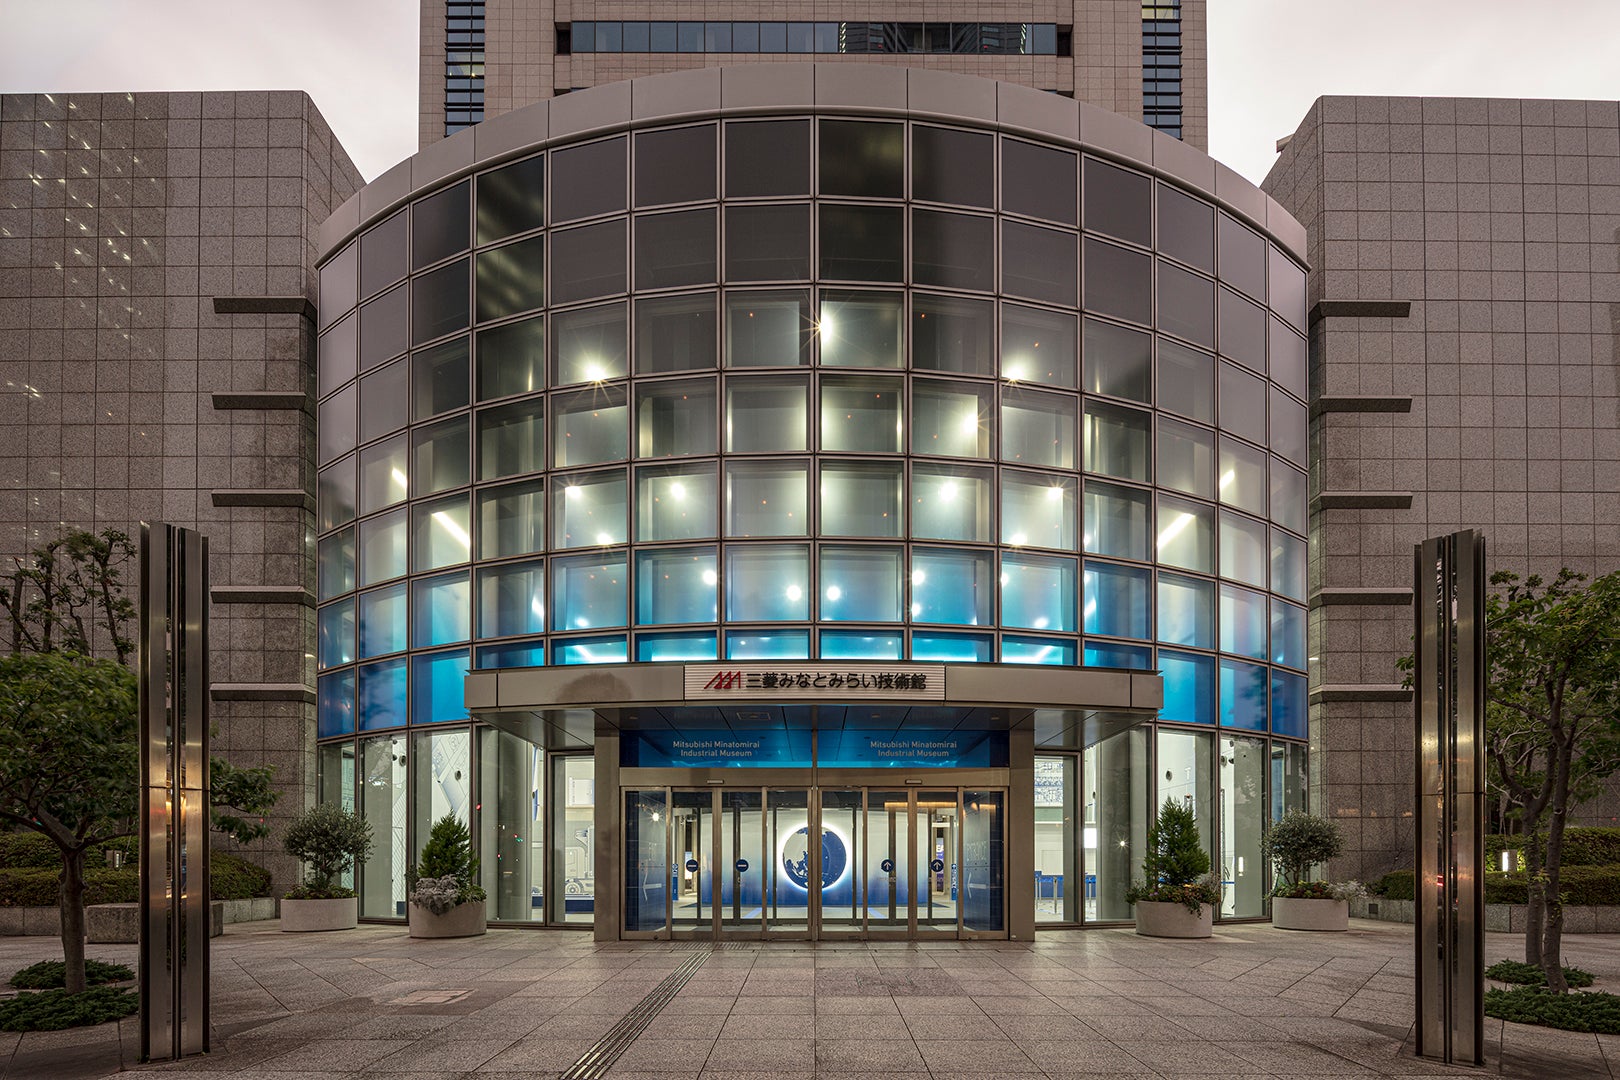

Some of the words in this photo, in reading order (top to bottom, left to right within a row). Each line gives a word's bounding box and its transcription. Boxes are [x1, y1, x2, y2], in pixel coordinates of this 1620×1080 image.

[746, 672, 926, 690] 三菱みなとみらい技術館
[672, 740, 713, 748] Mitsubishi
[714, 740, 760, 748] Minatomirai
[870, 740, 910, 748] Mitsubishi
[911, 740, 957, 748] Minatomirai
[680, 749, 718, 757] Industrial
[719, 749, 753, 757] Museum
[877, 749, 915, 757] Industrial
[917, 749, 950, 757] Museum
